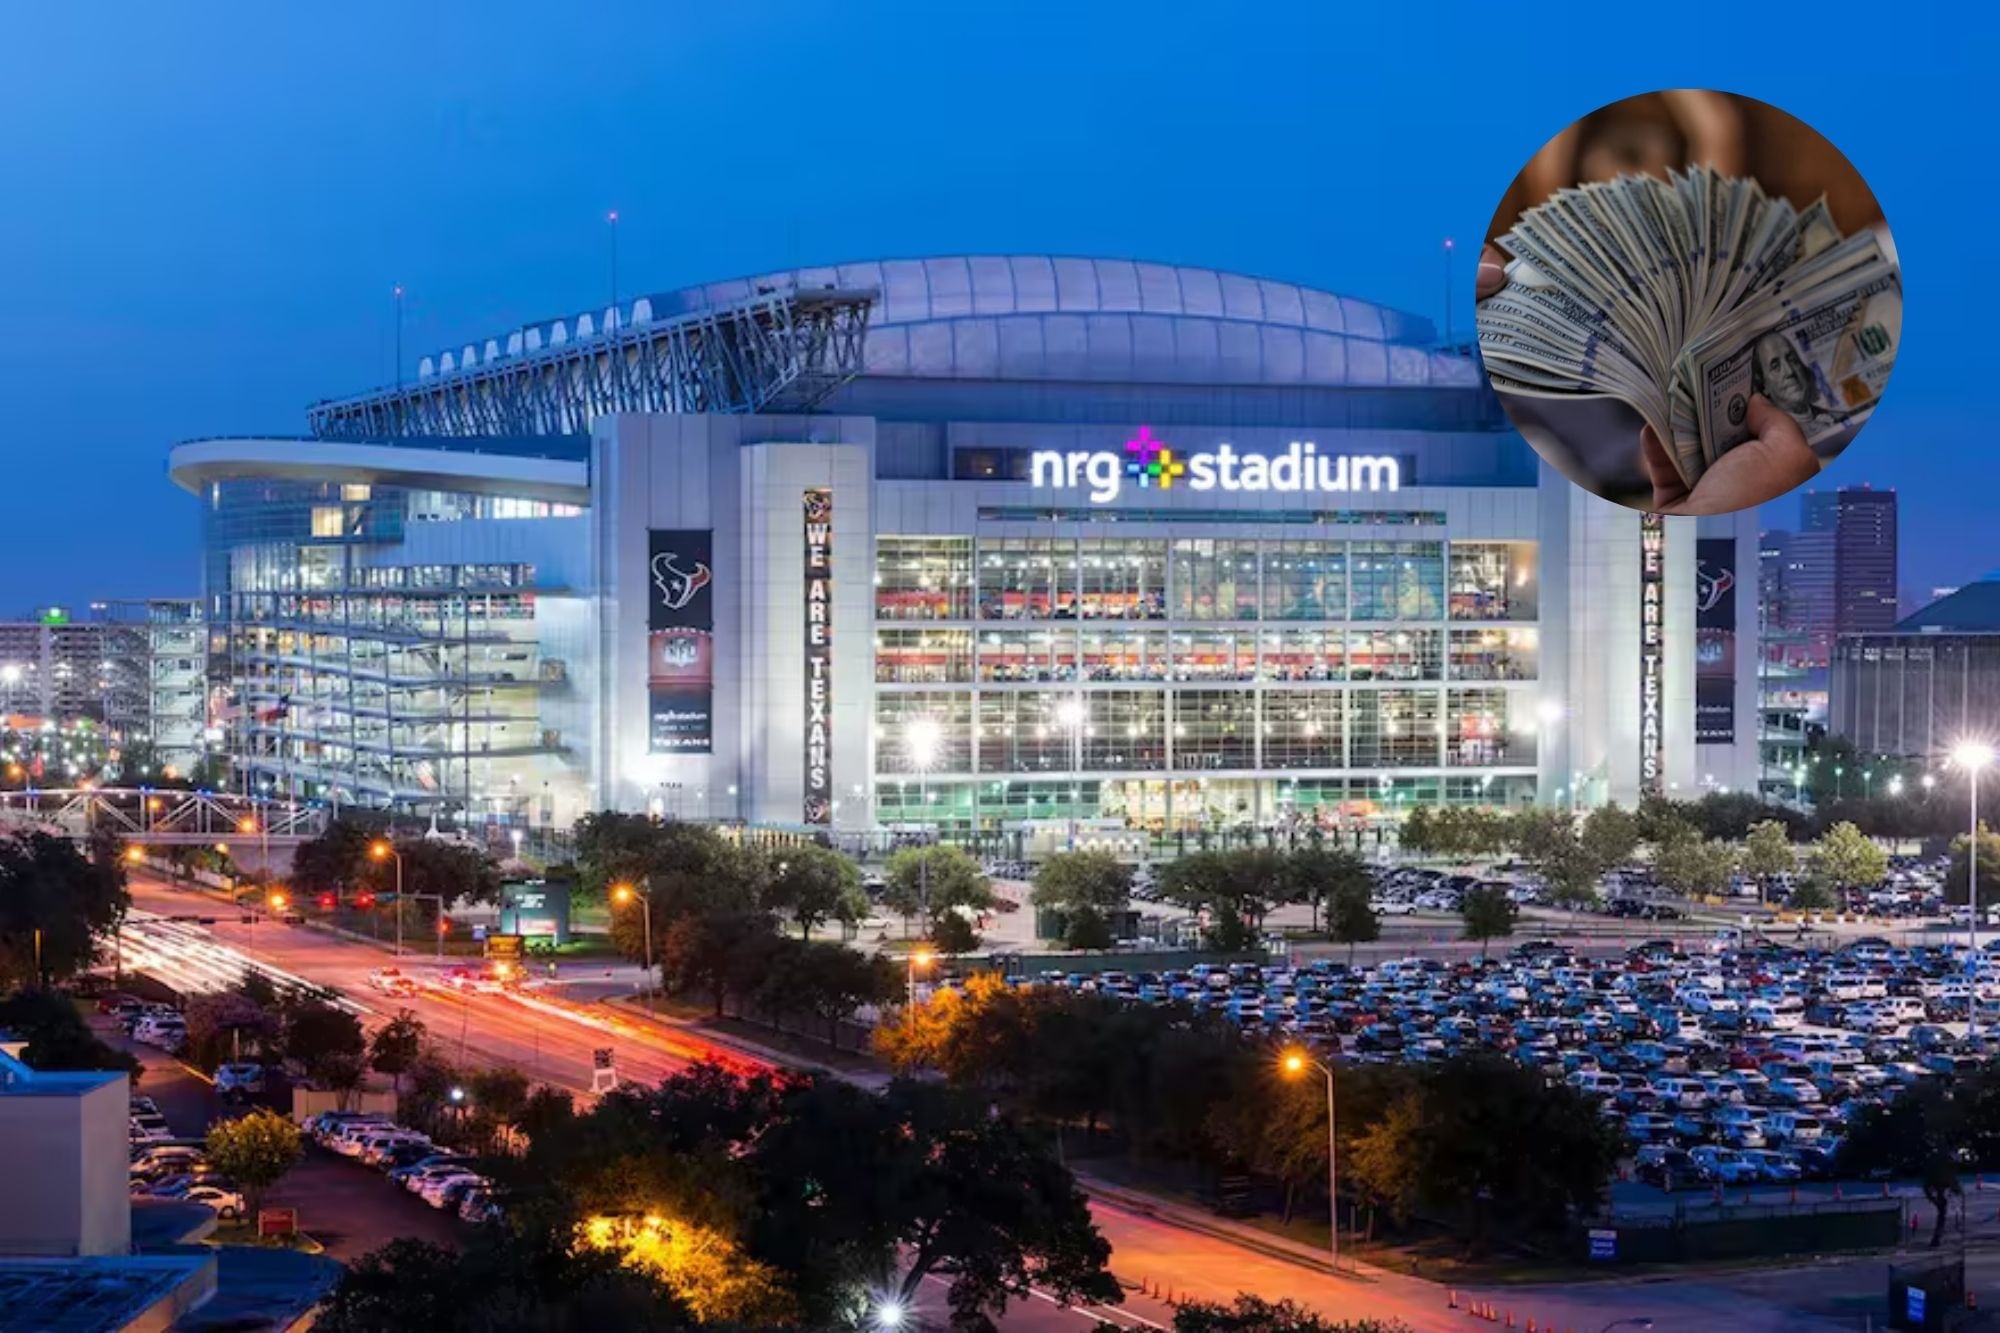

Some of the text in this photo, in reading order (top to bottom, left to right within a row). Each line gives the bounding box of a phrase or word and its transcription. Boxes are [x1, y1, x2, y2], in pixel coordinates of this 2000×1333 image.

[1031, 443, 1399, 503] nrg stadium
[807, 523, 828, 790] WE ARE TEXANS
[1642, 530, 1661, 778] WE ARE TEXANS
[653, 738, 710, 747] TEXANS
